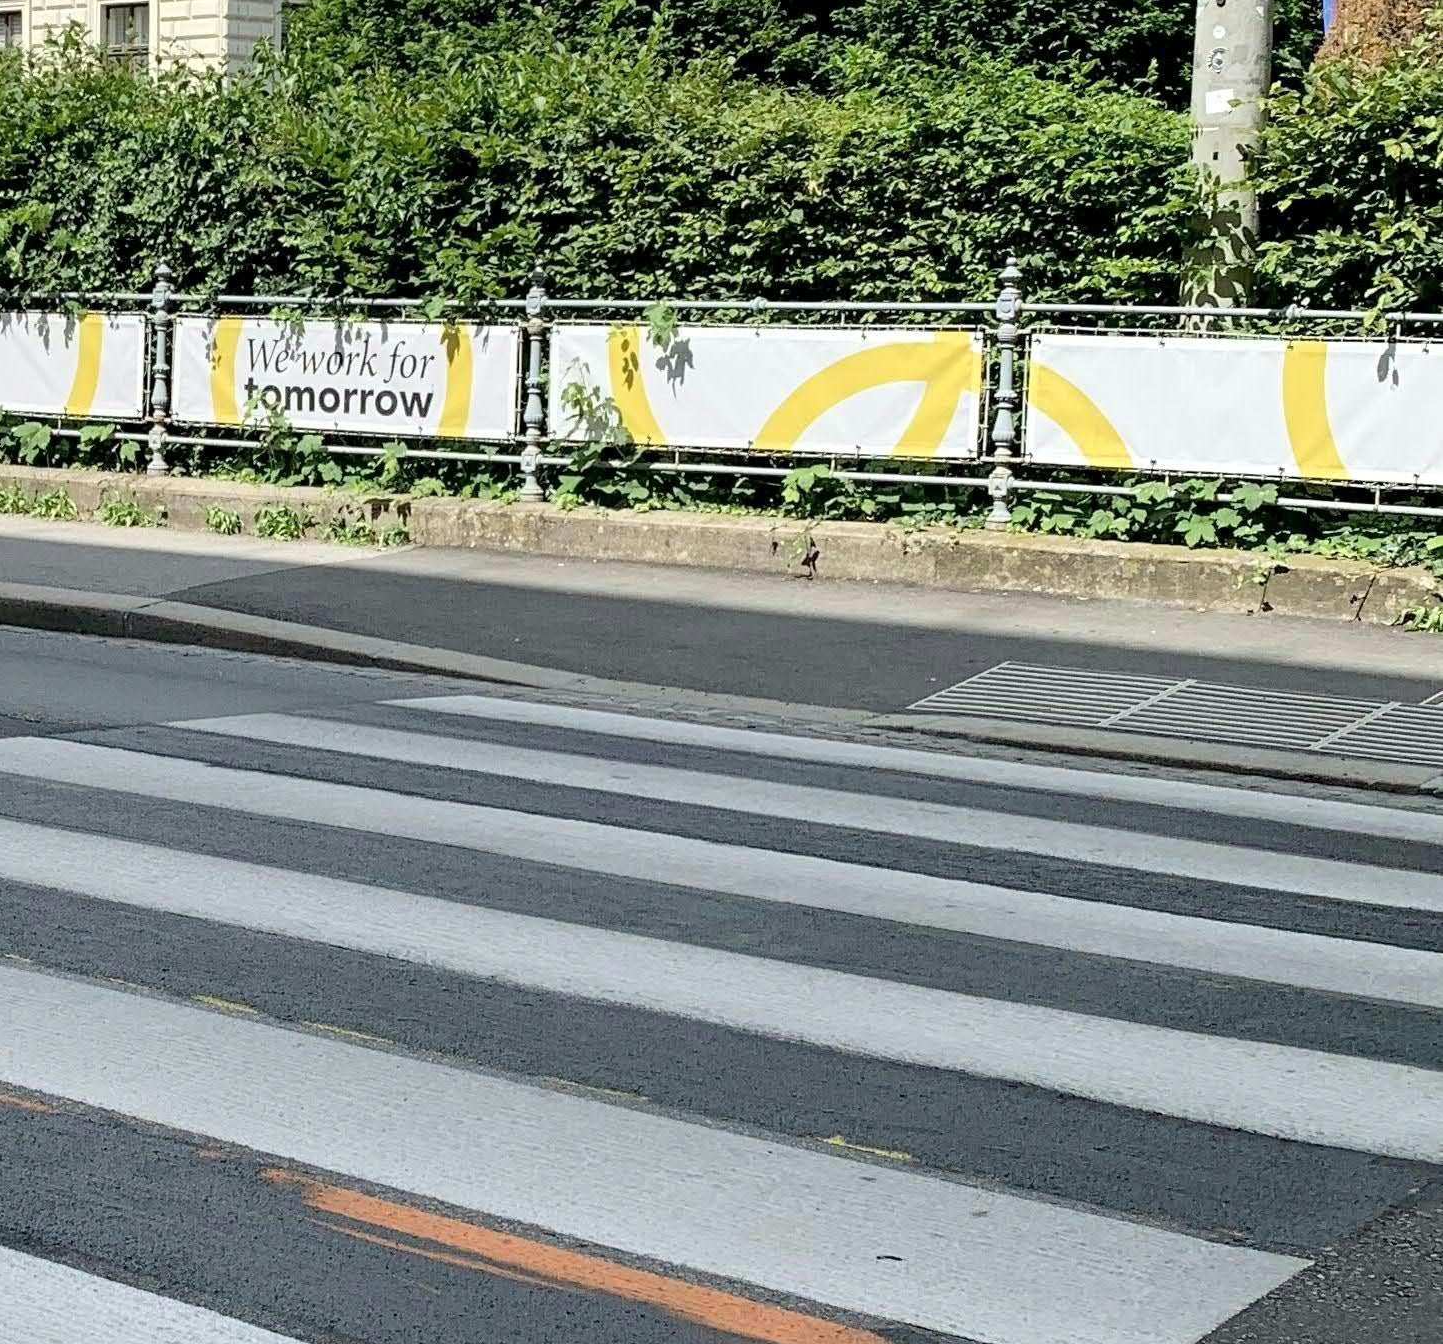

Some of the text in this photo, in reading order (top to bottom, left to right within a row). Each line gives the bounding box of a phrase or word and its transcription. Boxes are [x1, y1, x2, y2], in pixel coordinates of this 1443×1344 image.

[247, 338, 435, 383] We work for
[244, 377, 434, 418] tomorrow
